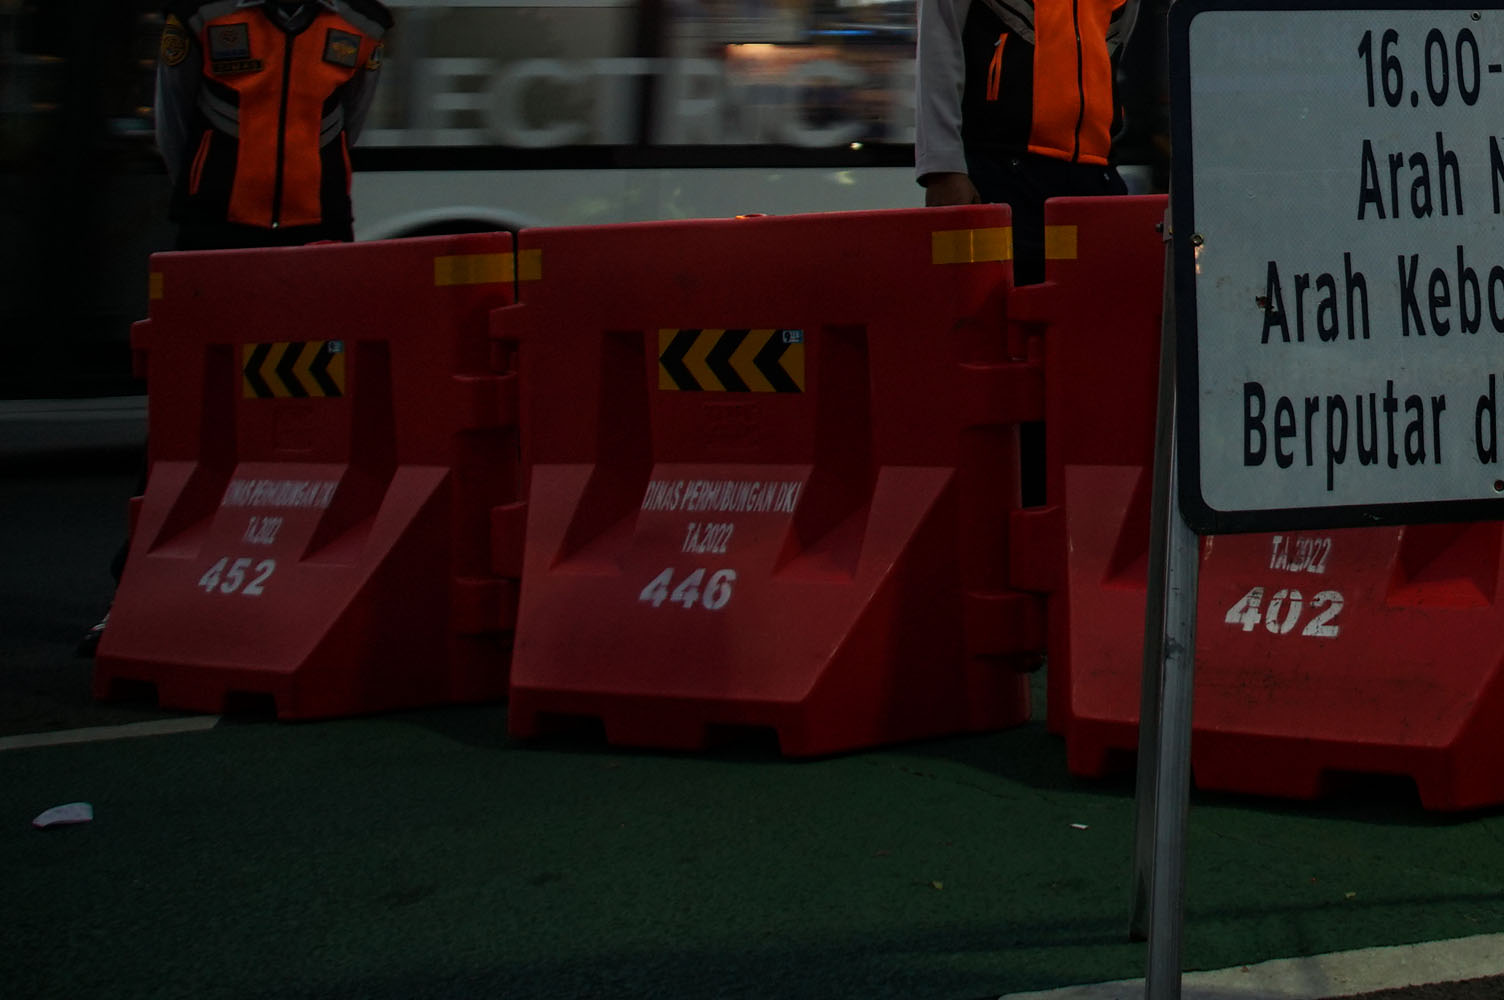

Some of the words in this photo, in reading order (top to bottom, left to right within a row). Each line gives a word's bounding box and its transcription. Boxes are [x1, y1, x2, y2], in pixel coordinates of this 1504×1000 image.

[1357, 131, 1464, 220] Arah
[1261, 252, 1371, 344] Arah
[1243, 379, 1446, 491] Berputar
[640, 480, 684, 511] DINAS
[680, 480, 777, 512] PERHUBUNGAN
[773, 480, 802, 513] DKI
[198, 556, 277, 596] 452
[638, 567, 737, 611] 446
[1224, 586, 1345, 638] 402
